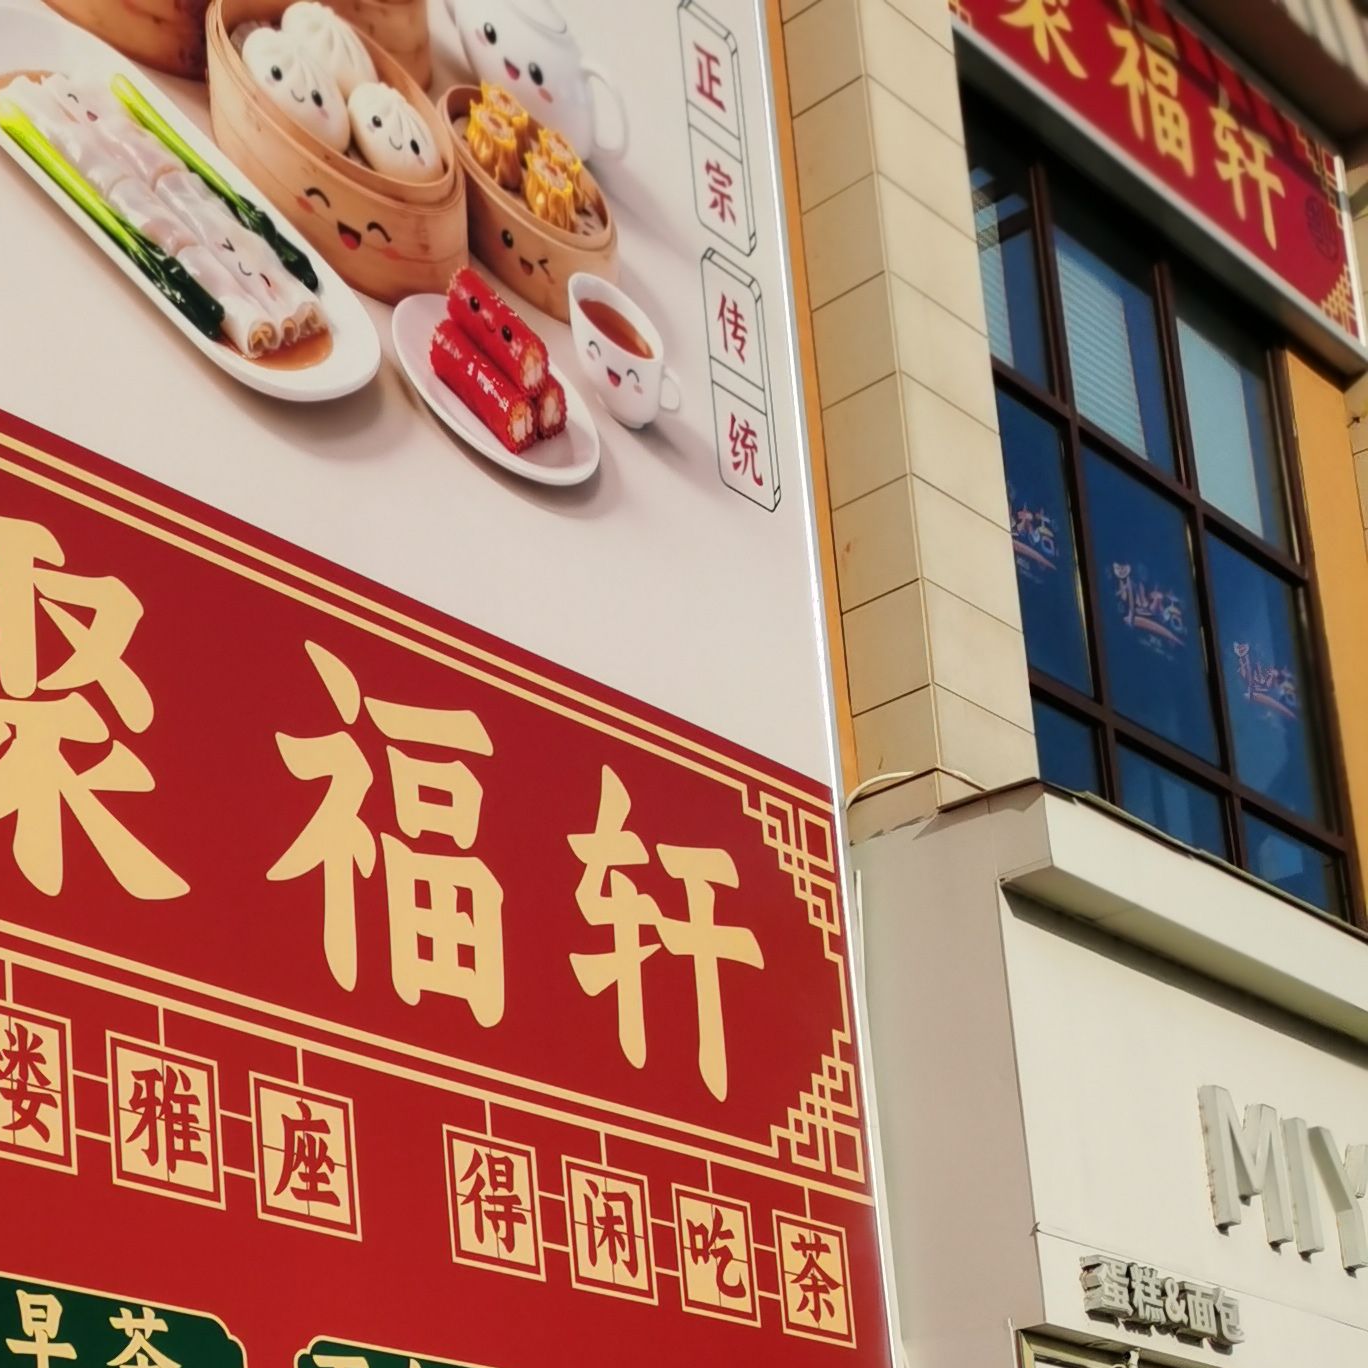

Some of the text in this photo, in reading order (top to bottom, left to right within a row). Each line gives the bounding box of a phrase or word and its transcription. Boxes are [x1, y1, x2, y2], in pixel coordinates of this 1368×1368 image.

[693, 41, 737, 227] 正宗
[717, 292, 764, 487] 传统
[456, 1150, 844, 1323] 得闲吃茶
[1081, 1254, 1245, 1346] 蛋糕&面包
